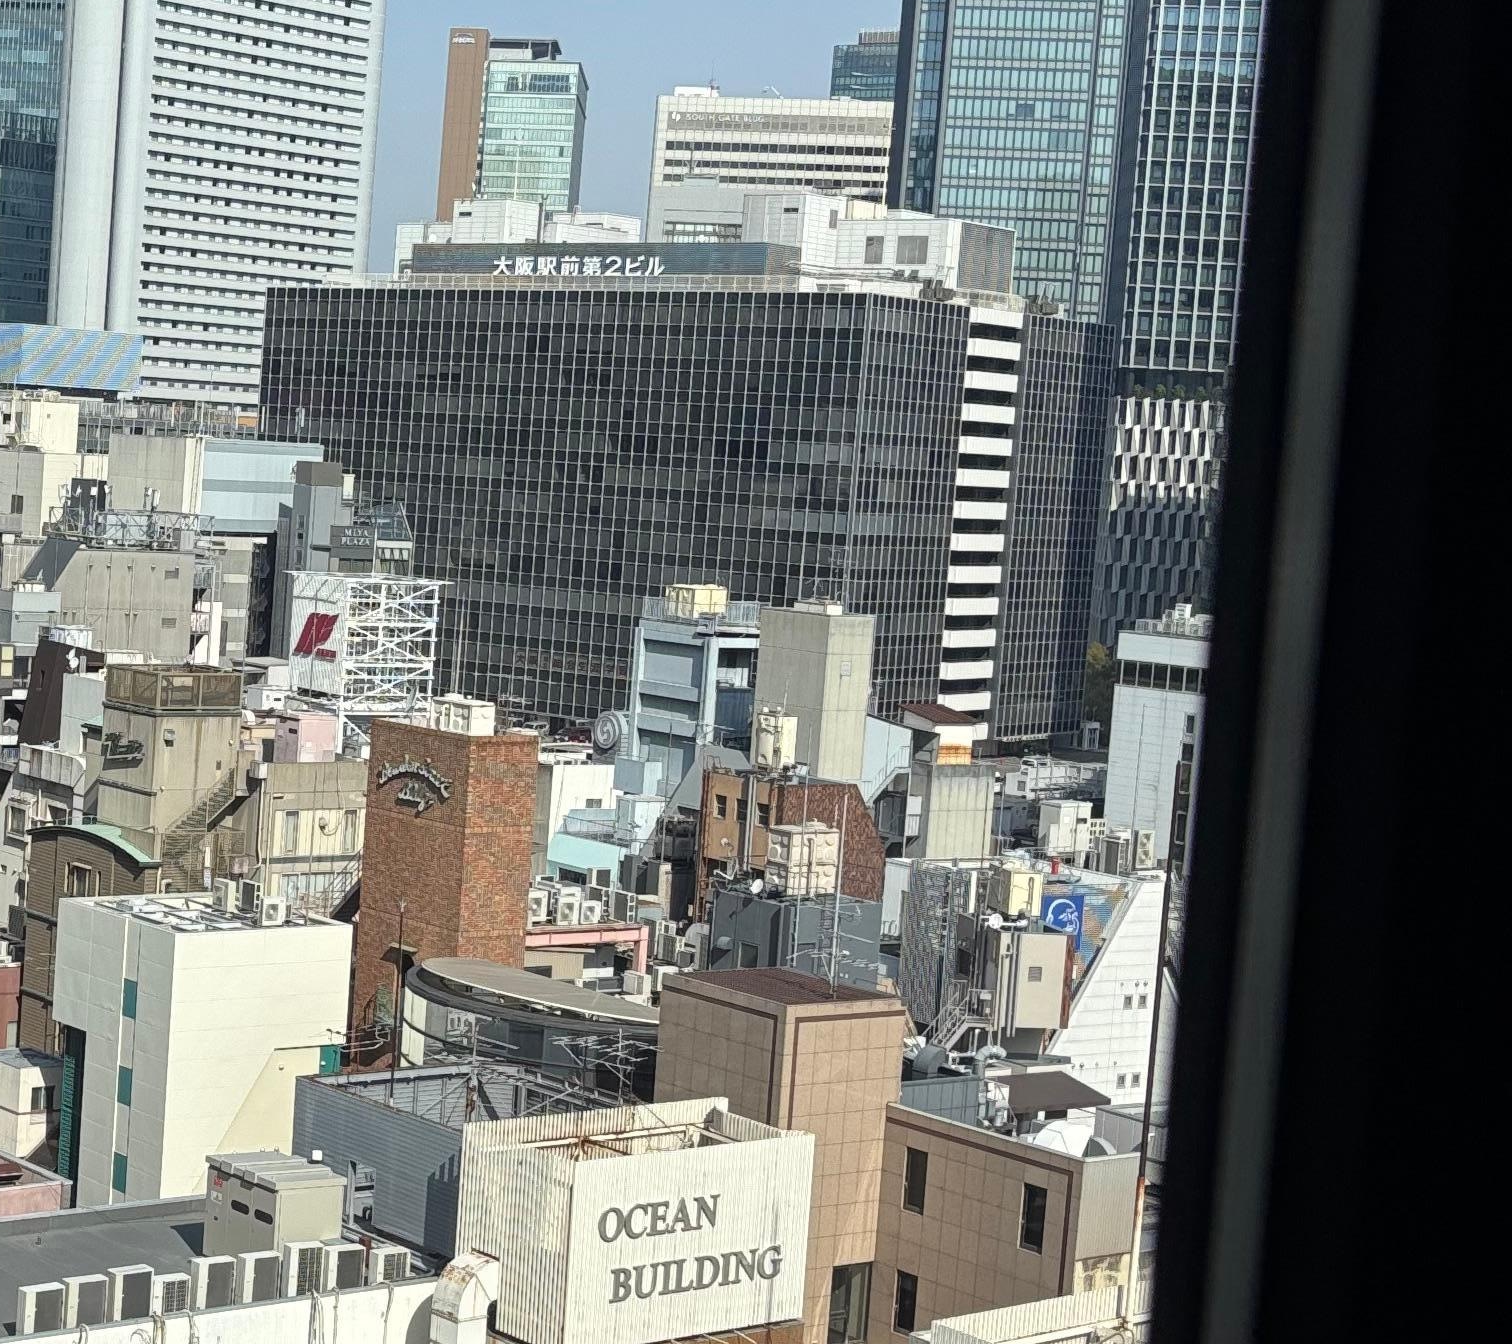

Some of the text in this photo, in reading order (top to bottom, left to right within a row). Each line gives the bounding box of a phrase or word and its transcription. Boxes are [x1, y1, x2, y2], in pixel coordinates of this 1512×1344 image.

[493, 255, 666, 277] 大阪駅前第2ビル
[340, 536, 371, 546] PLAZA
[597, 1193, 721, 1243] OCEAN
[608, 1244, 783, 1304] BUILDING
